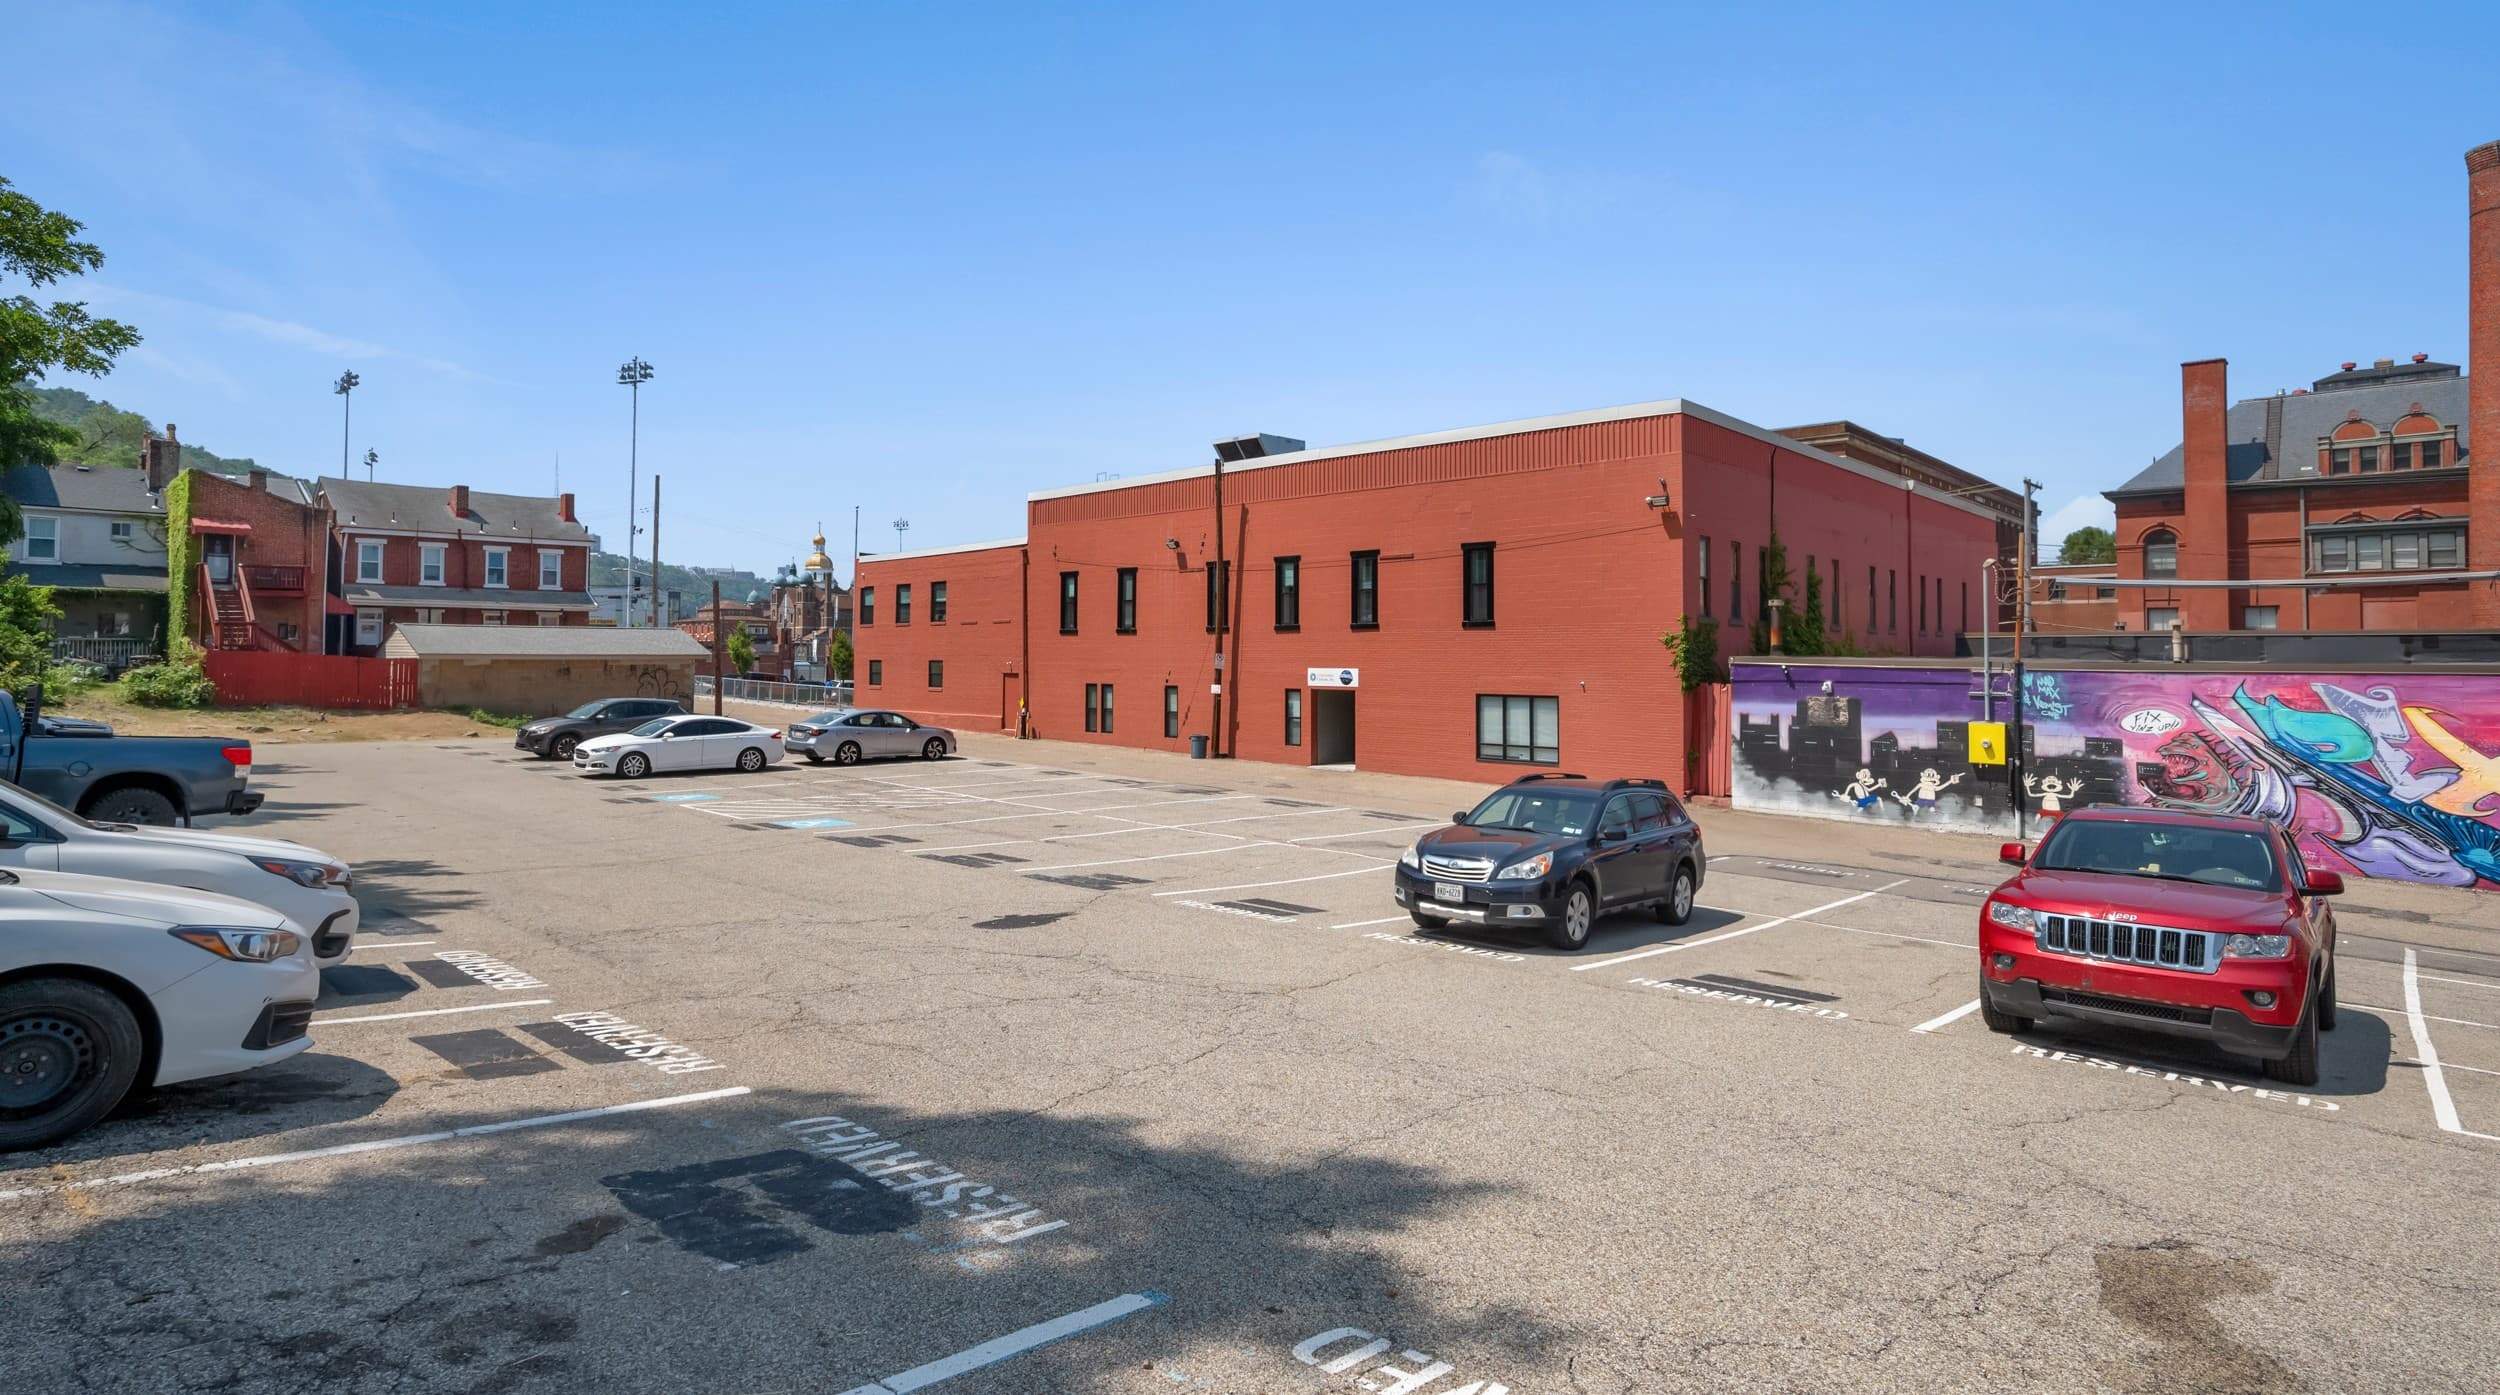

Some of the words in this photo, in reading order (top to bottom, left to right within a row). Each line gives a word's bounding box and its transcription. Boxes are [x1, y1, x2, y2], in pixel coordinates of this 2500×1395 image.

[2039, 686, 2061, 700] MAX
[2134, 711, 2161, 727] FIX
[433, 950, 549, 991] RESERVED
[1628, 978, 1849, 1020] RESERVED
[552, 1011, 727, 1074] RESERVED
[2011, 1045, 2340, 1111] RESERVED
[784, 1115, 1069, 1243] RESERVED
